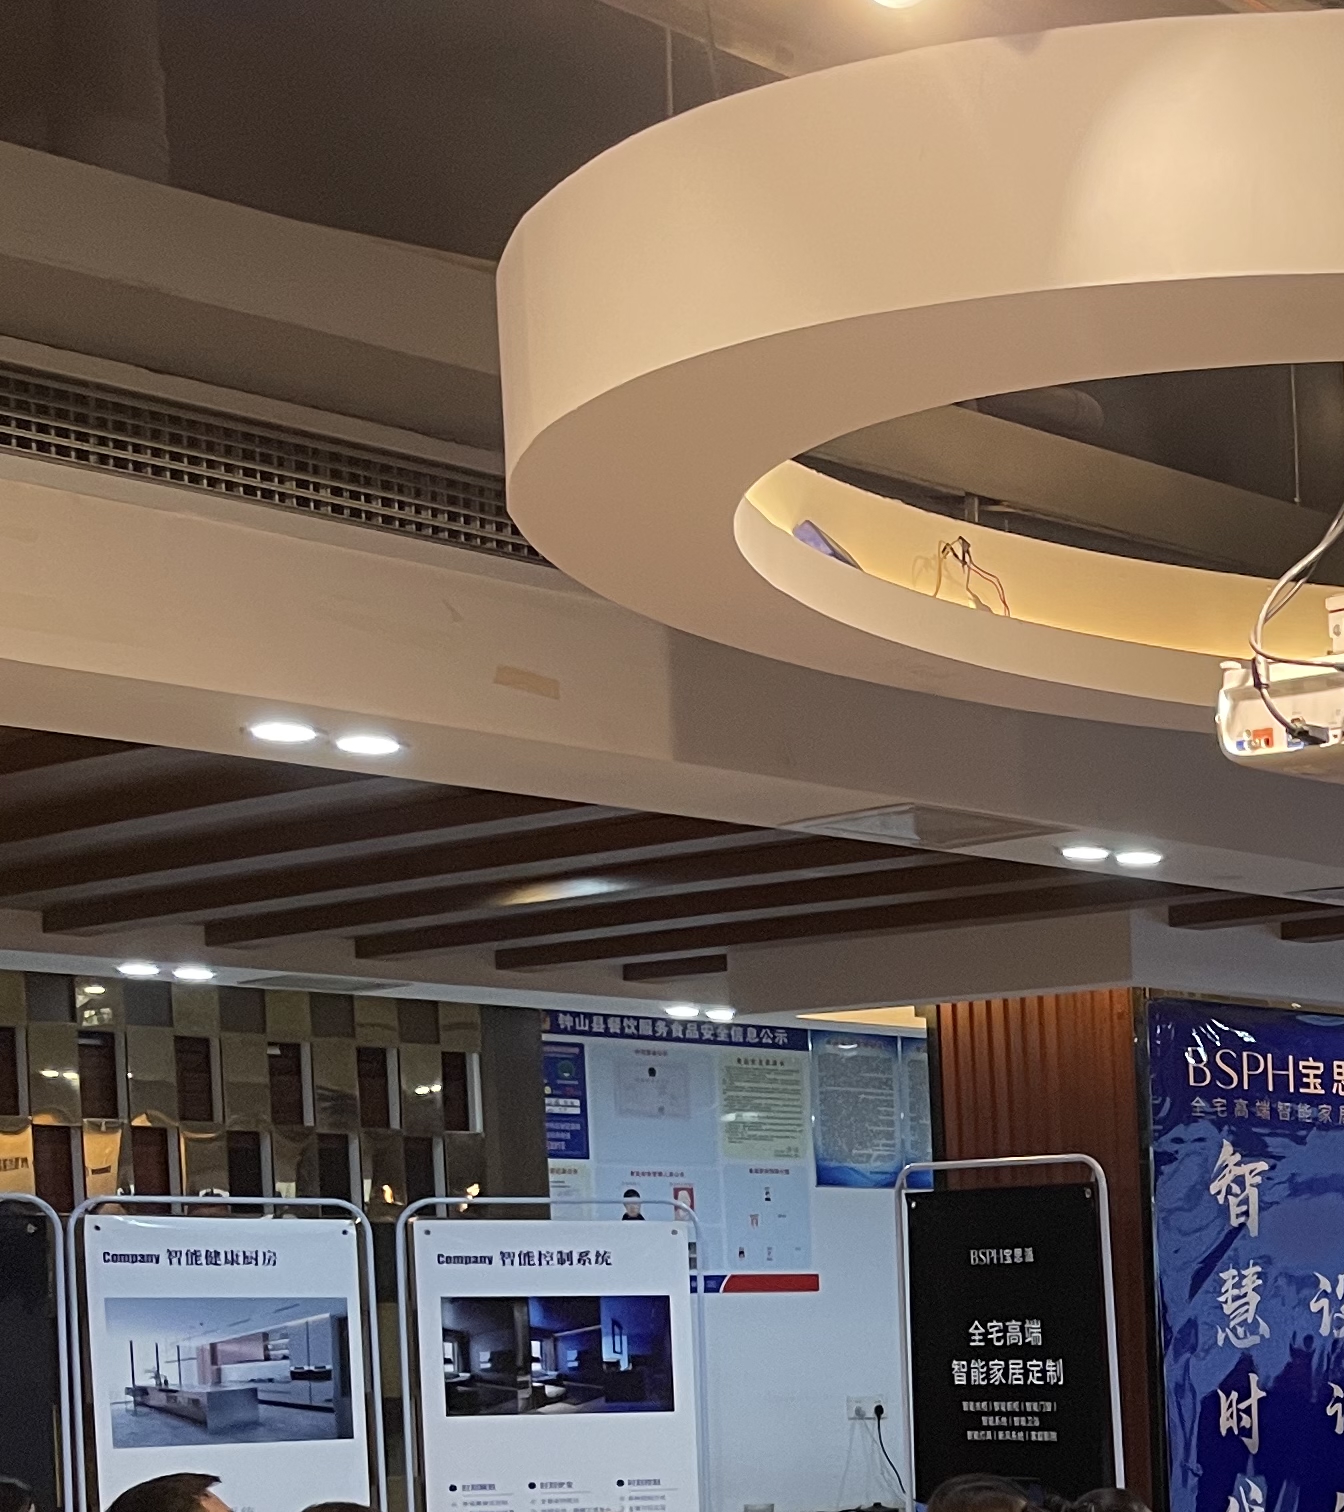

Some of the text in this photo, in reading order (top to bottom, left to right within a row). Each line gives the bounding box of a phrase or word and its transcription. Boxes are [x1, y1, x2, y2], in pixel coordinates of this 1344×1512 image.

[103, 1249, 277, 1267] Company 智能健康厨房
[437, 1250, 612, 1267] Company 智能控制系统
[968, 1319, 1042, 1346] 全宅高端
[951, 1359, 1064, 1386] 智能家居定制
